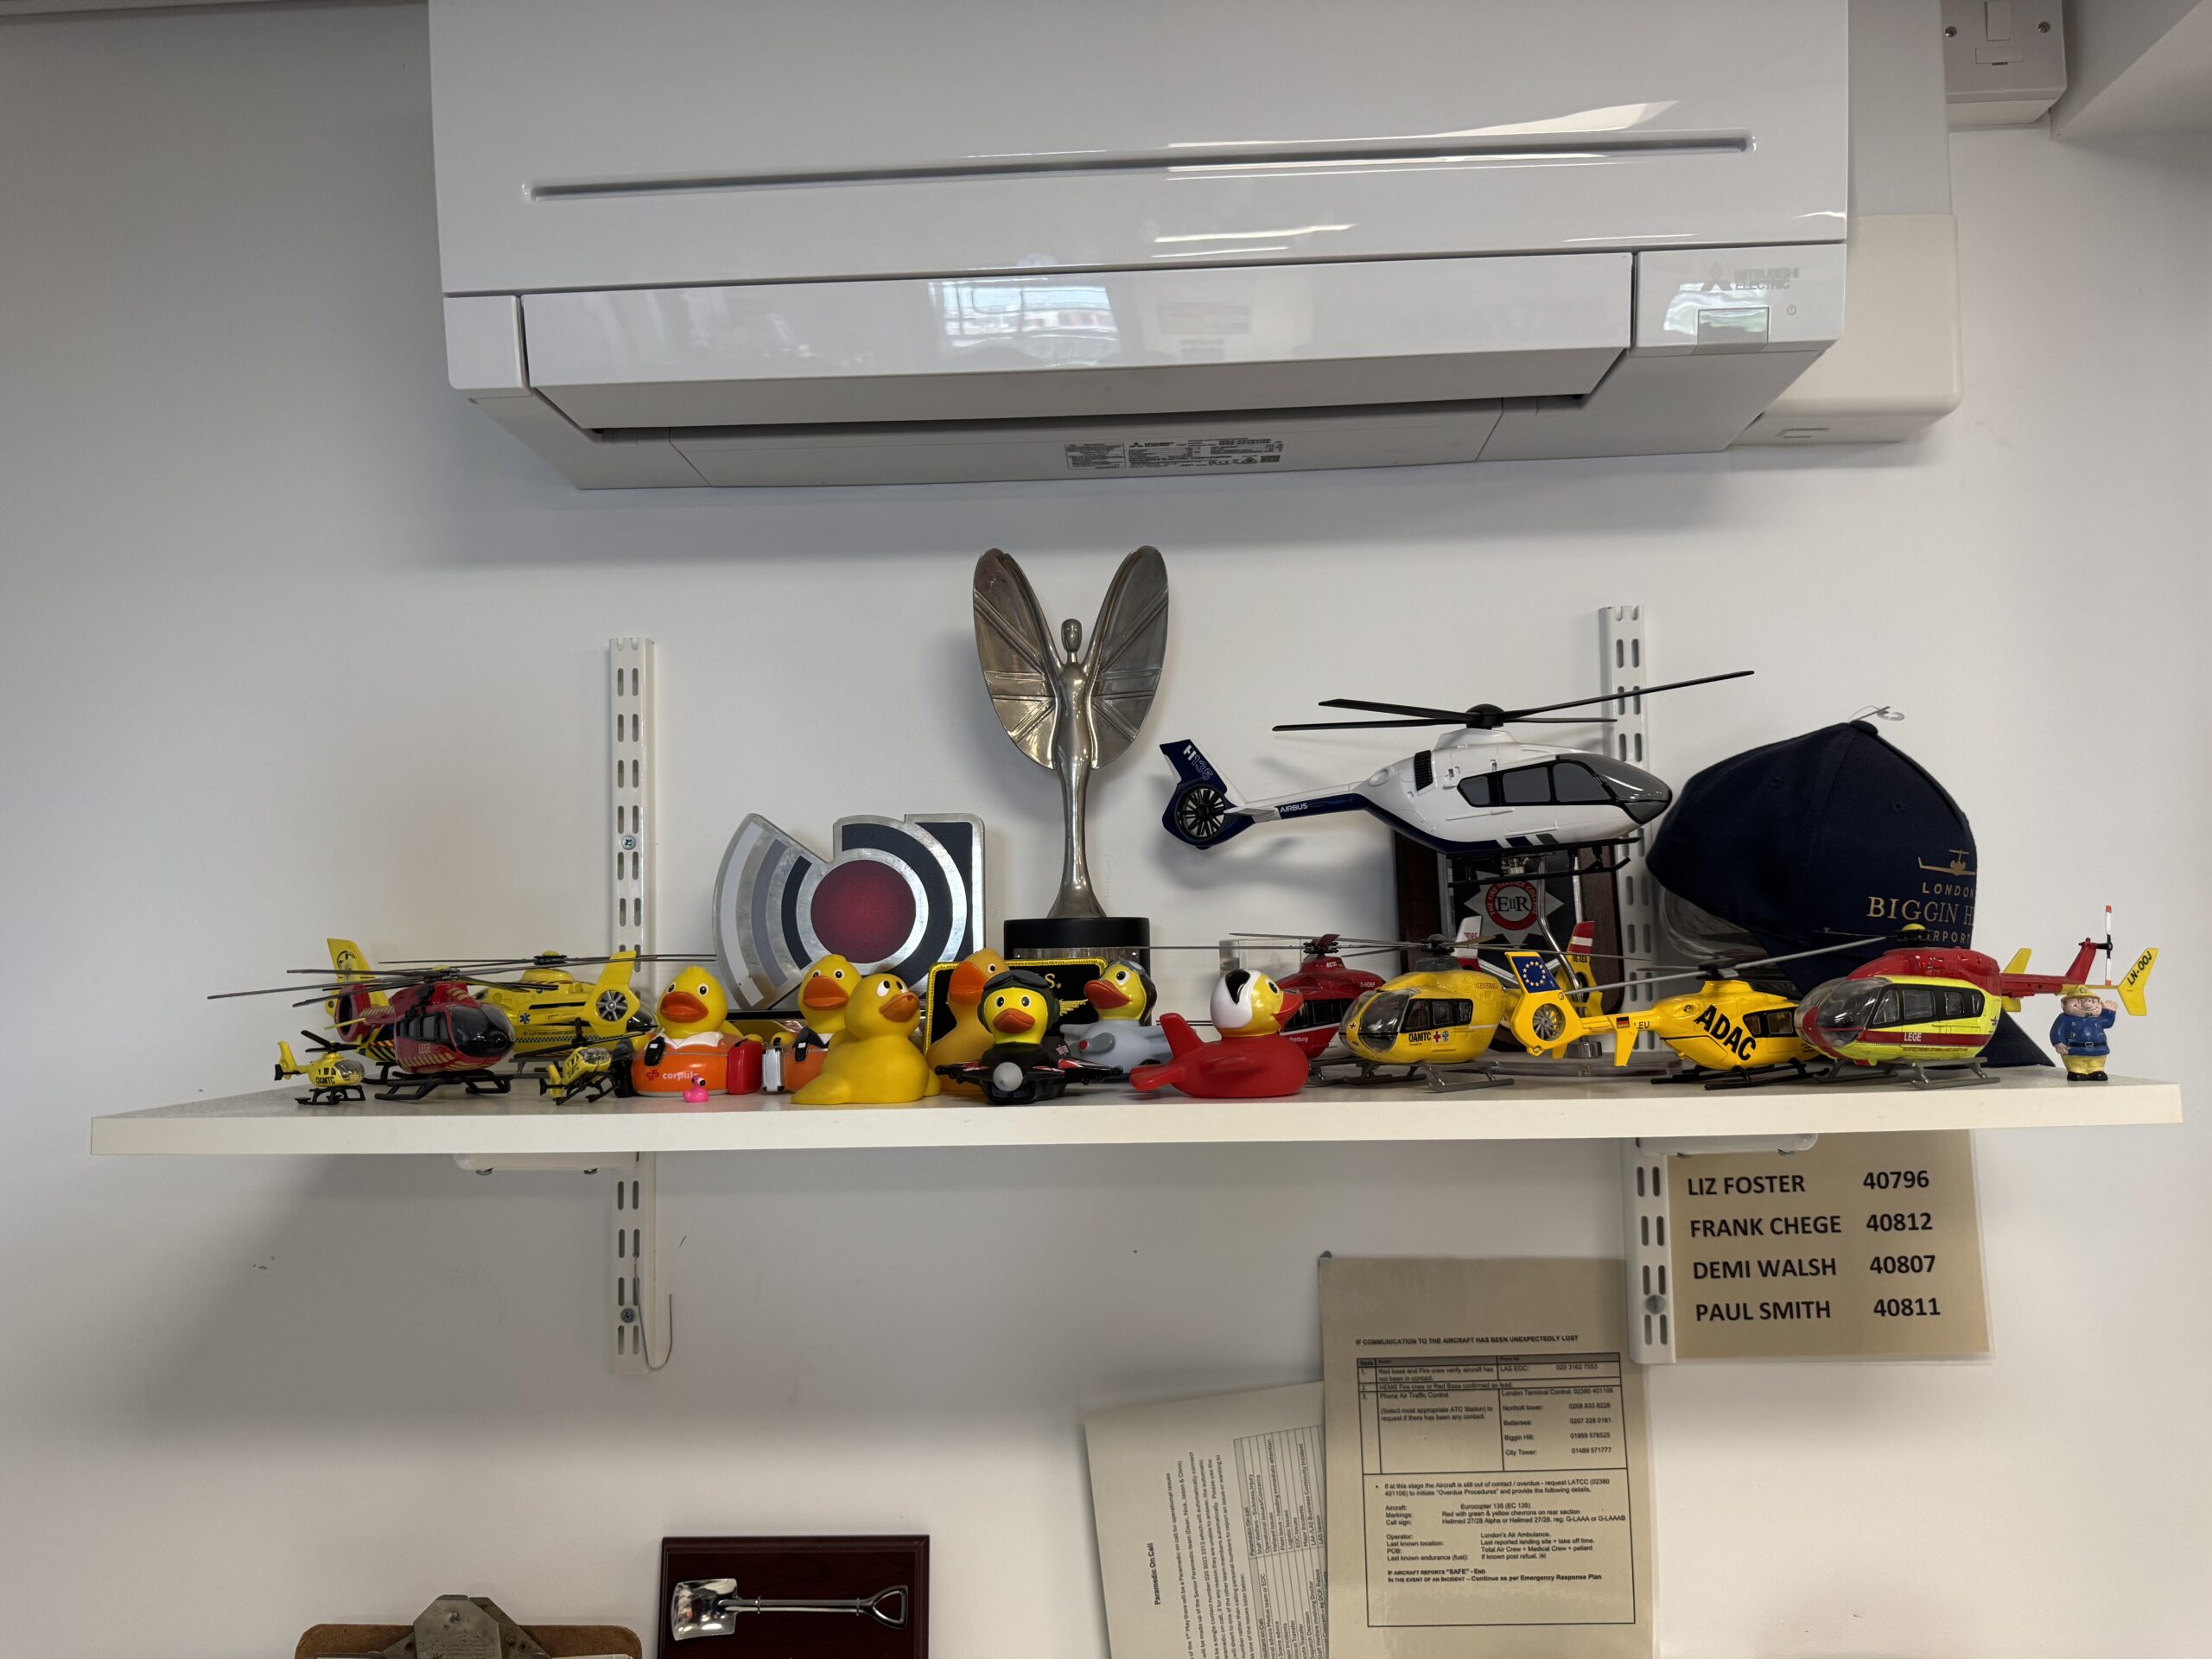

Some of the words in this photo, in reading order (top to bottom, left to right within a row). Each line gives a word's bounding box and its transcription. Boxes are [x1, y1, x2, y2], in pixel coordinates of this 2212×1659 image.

[1183, 744, 1213, 780] H135
[1280, 803, 1307, 813] AIRBUS
[1922, 881, 1974, 899] LONDON
[1866, 896, 1960, 924] BIGGIN
[1926, 929, 1971, 944] IRPORT
[2126, 950, 2152, 986] LN-OOJ
[1694, 1004, 1757, 1061] ADAC
[1904, 1033, 1922, 1042] LEGE
[662, 1071, 699, 1081] corpul
[1688, 1177, 1717, 1196] LIZ
[1724, 1175, 1806, 1194] FOSTER
[1863, 1170, 1929, 1190] 40796
[1690, 1217, 1764, 1237] FRANK
[1770, 1215, 1842, 1236] CHEGE
[1866, 1212, 1933, 1232] 40812
[1693, 1260, 1751, 1280] DEMI
[1758, 1258, 1837, 1277] WALSH
[1869, 1255, 1936, 1274] 40807
[1695, 1303, 1753, 1322] PAUL
[1759, 1300, 1831, 1320] SMITH
[1873, 1298, 1941, 1317] 40811
[1149, 1557, 1155, 1567] On
[1150, 1568, 1160, 1605] Paramedic
